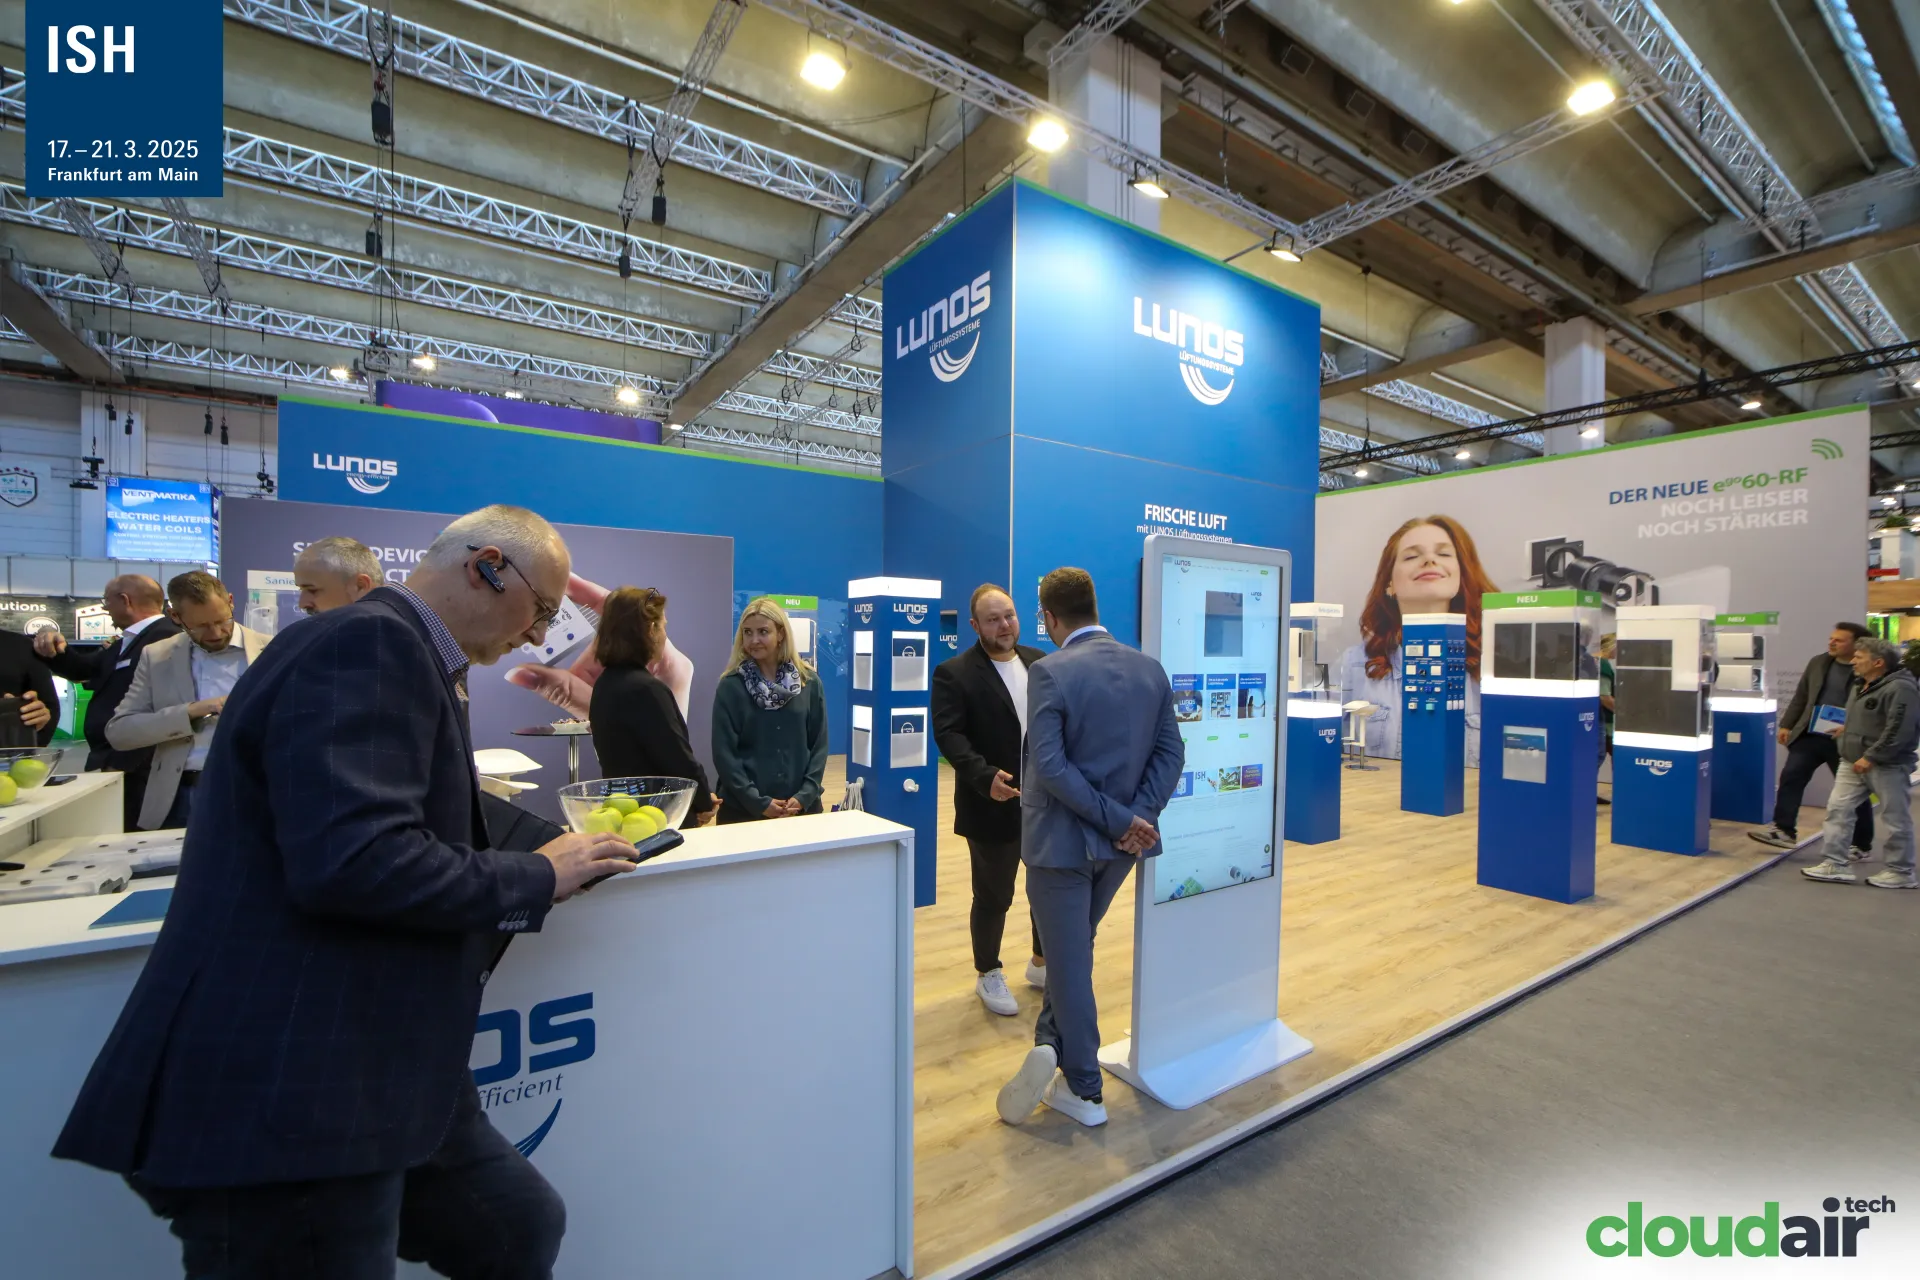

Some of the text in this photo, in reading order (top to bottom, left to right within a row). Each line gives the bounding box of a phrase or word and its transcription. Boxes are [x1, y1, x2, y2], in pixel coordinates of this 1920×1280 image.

[896, 270, 991, 360] LUNOS
[929, 319, 981, 354] LÜFTUNGSSYSTEME
[1133, 295, 1244, 367] LUNOS
[313, 453, 398, 477] LUNOS
[122, 489, 197, 502] VENTMATIKA
[1609, 487, 1648, 505] DER
[1652, 480, 1709, 500] NEUE
[1661, 488, 1809, 518] NOCH LEISER
[107, 511, 211, 525] ELECTRIC HEATERS
[1144, 503, 1228, 531] FRISCHE LUFT
[1638, 508, 1809, 539] NOCH STÄRKER
[117, 522, 203, 535] WATER COILS
[1136, 524, 1149, 534] mit
[1150, 525, 1175, 537] LUNOS
[370, 547, 428, 563] DEVIC
[265, 576, 296, 586] Sanie
[385, 568, 410, 583] CT
[785, 598, 801, 606] NEU
[1516, 595, 1539, 604] NEU
[0, 601, 47, 612] utions
[854, 603, 874, 613] LUNOS
[893, 603, 928, 614] LUNOS
[939, 634, 958, 642] LUNO
[1318, 728, 1337, 737] LUNOS
[1634, 757, 1673, 769] LUNOS
[1195, 770, 1206, 780] ISH
